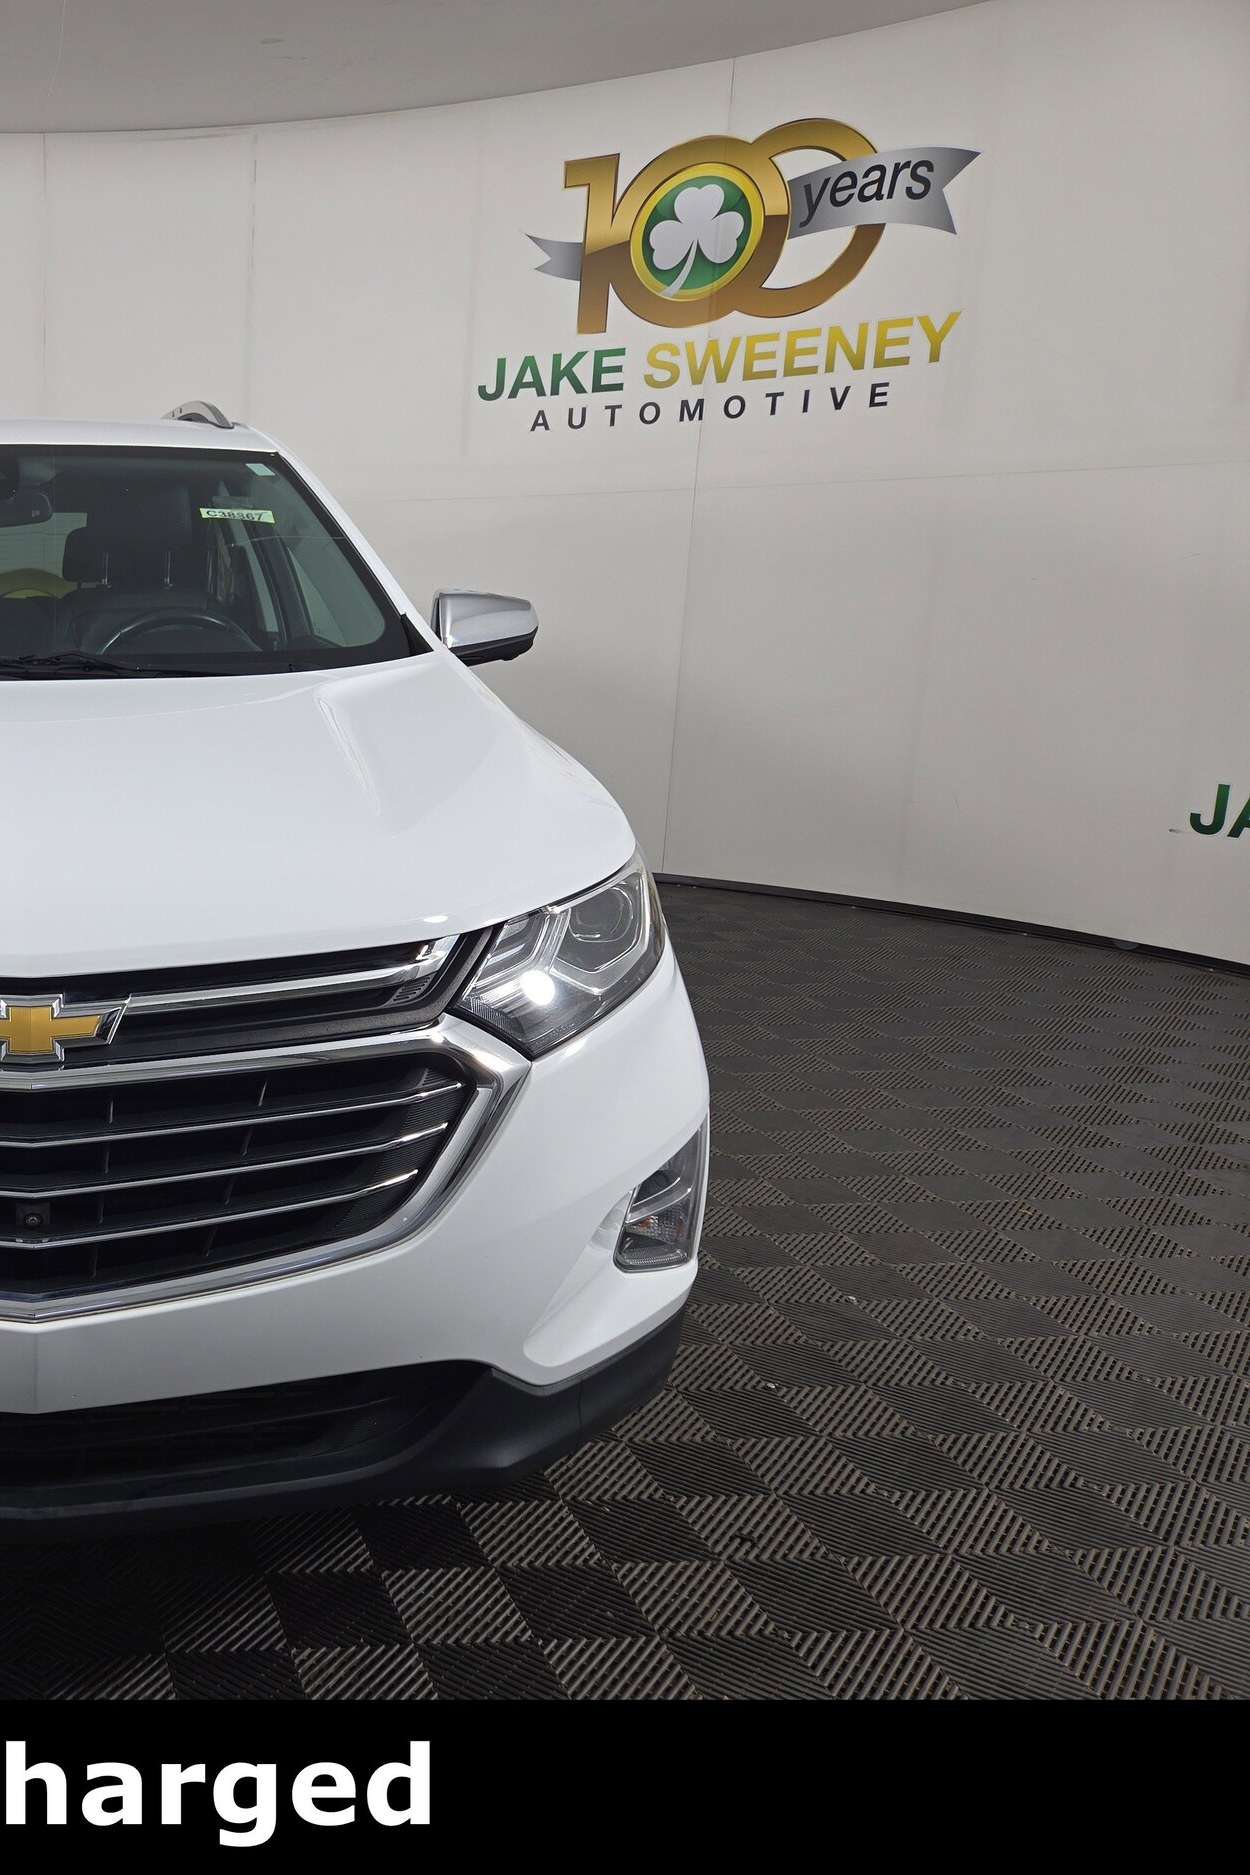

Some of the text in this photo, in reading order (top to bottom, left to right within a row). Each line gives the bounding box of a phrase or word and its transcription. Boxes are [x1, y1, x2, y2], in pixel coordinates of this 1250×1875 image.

[563, 117, 934, 335] 100 years
[477, 311, 962, 401] JAKE SWEENEY
[530, 381, 890, 432] AUTOMOTIVE
